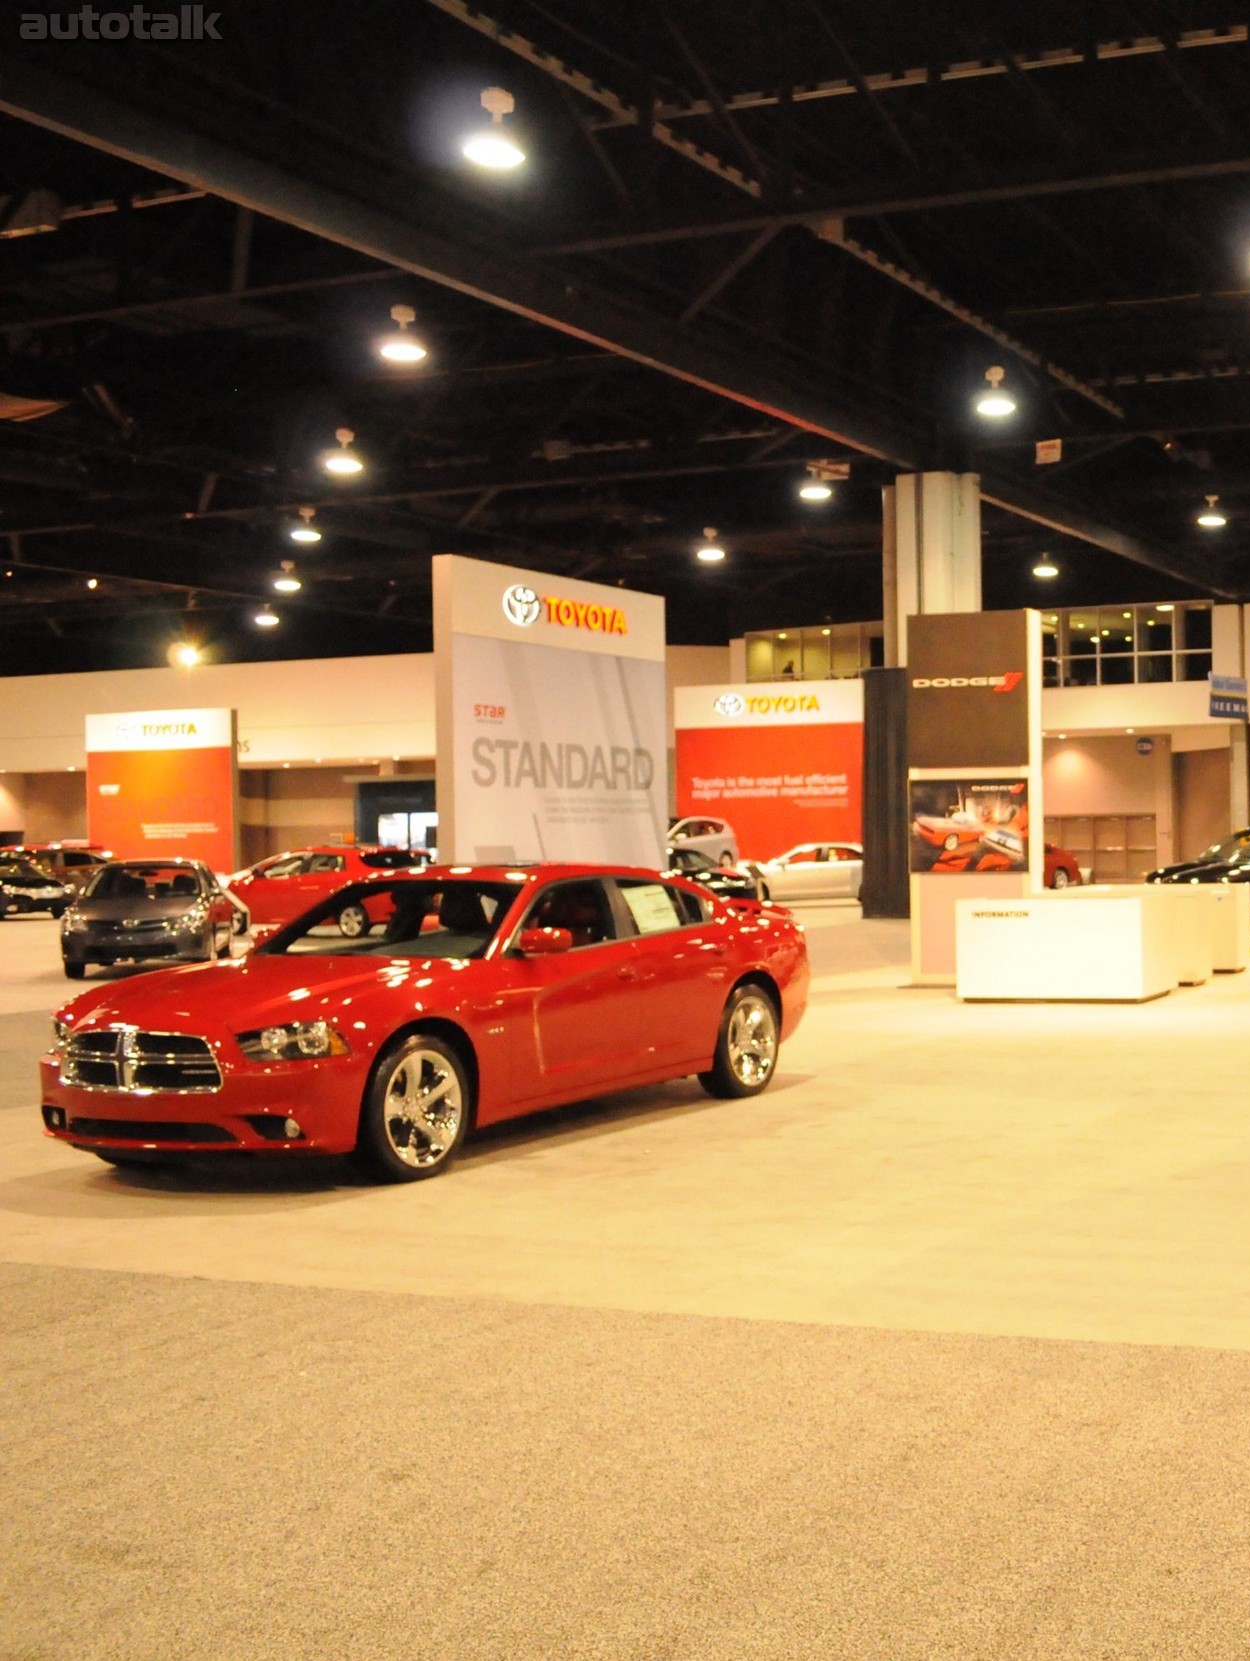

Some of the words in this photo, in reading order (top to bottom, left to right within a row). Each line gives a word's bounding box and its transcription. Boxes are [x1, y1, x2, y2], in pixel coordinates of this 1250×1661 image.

[543, 596, 628, 635] TOYOTA
[912, 676, 1007, 688] DODGE
[746, 695, 820, 713] TOYOTA
[142, 723, 197, 736] TOYOTA
[471, 736, 655, 791] STANDARD
